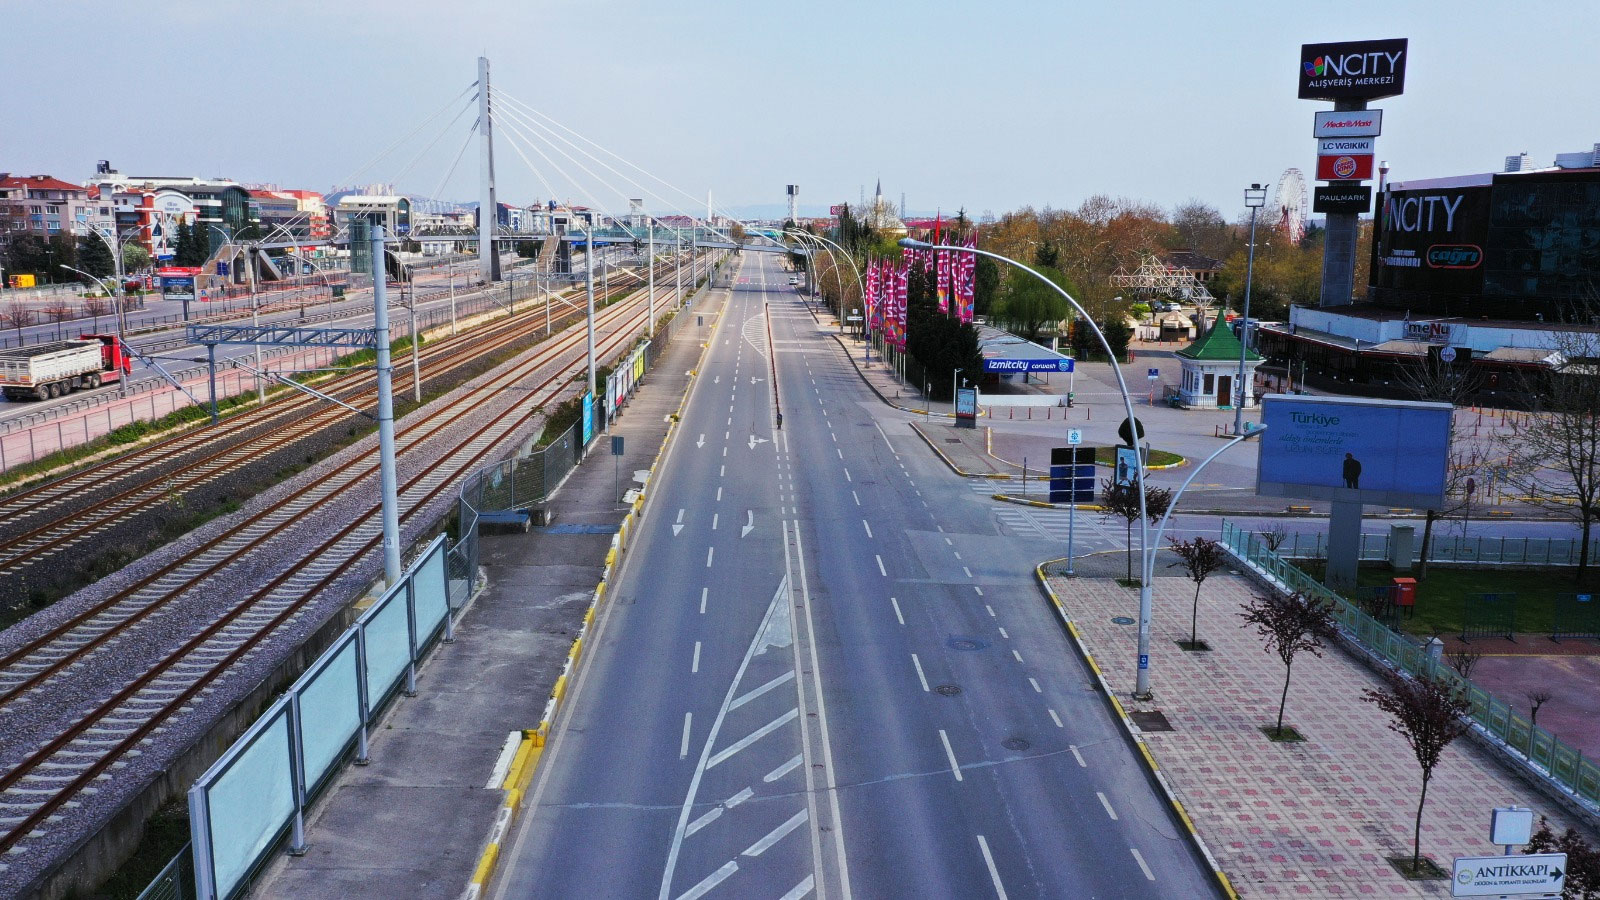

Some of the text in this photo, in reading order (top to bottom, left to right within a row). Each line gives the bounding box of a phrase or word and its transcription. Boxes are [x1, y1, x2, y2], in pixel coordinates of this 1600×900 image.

[1308, 75, 1394, 88] ALIŞVERİŞ MERKEZİ
[1322, 142, 1334, 150] LC
[988, 360, 1029, 371] izmitcity
[1289, 411, 1340, 427] Türkiye
[1475, 864, 1548, 878] ANTİKKAPI
